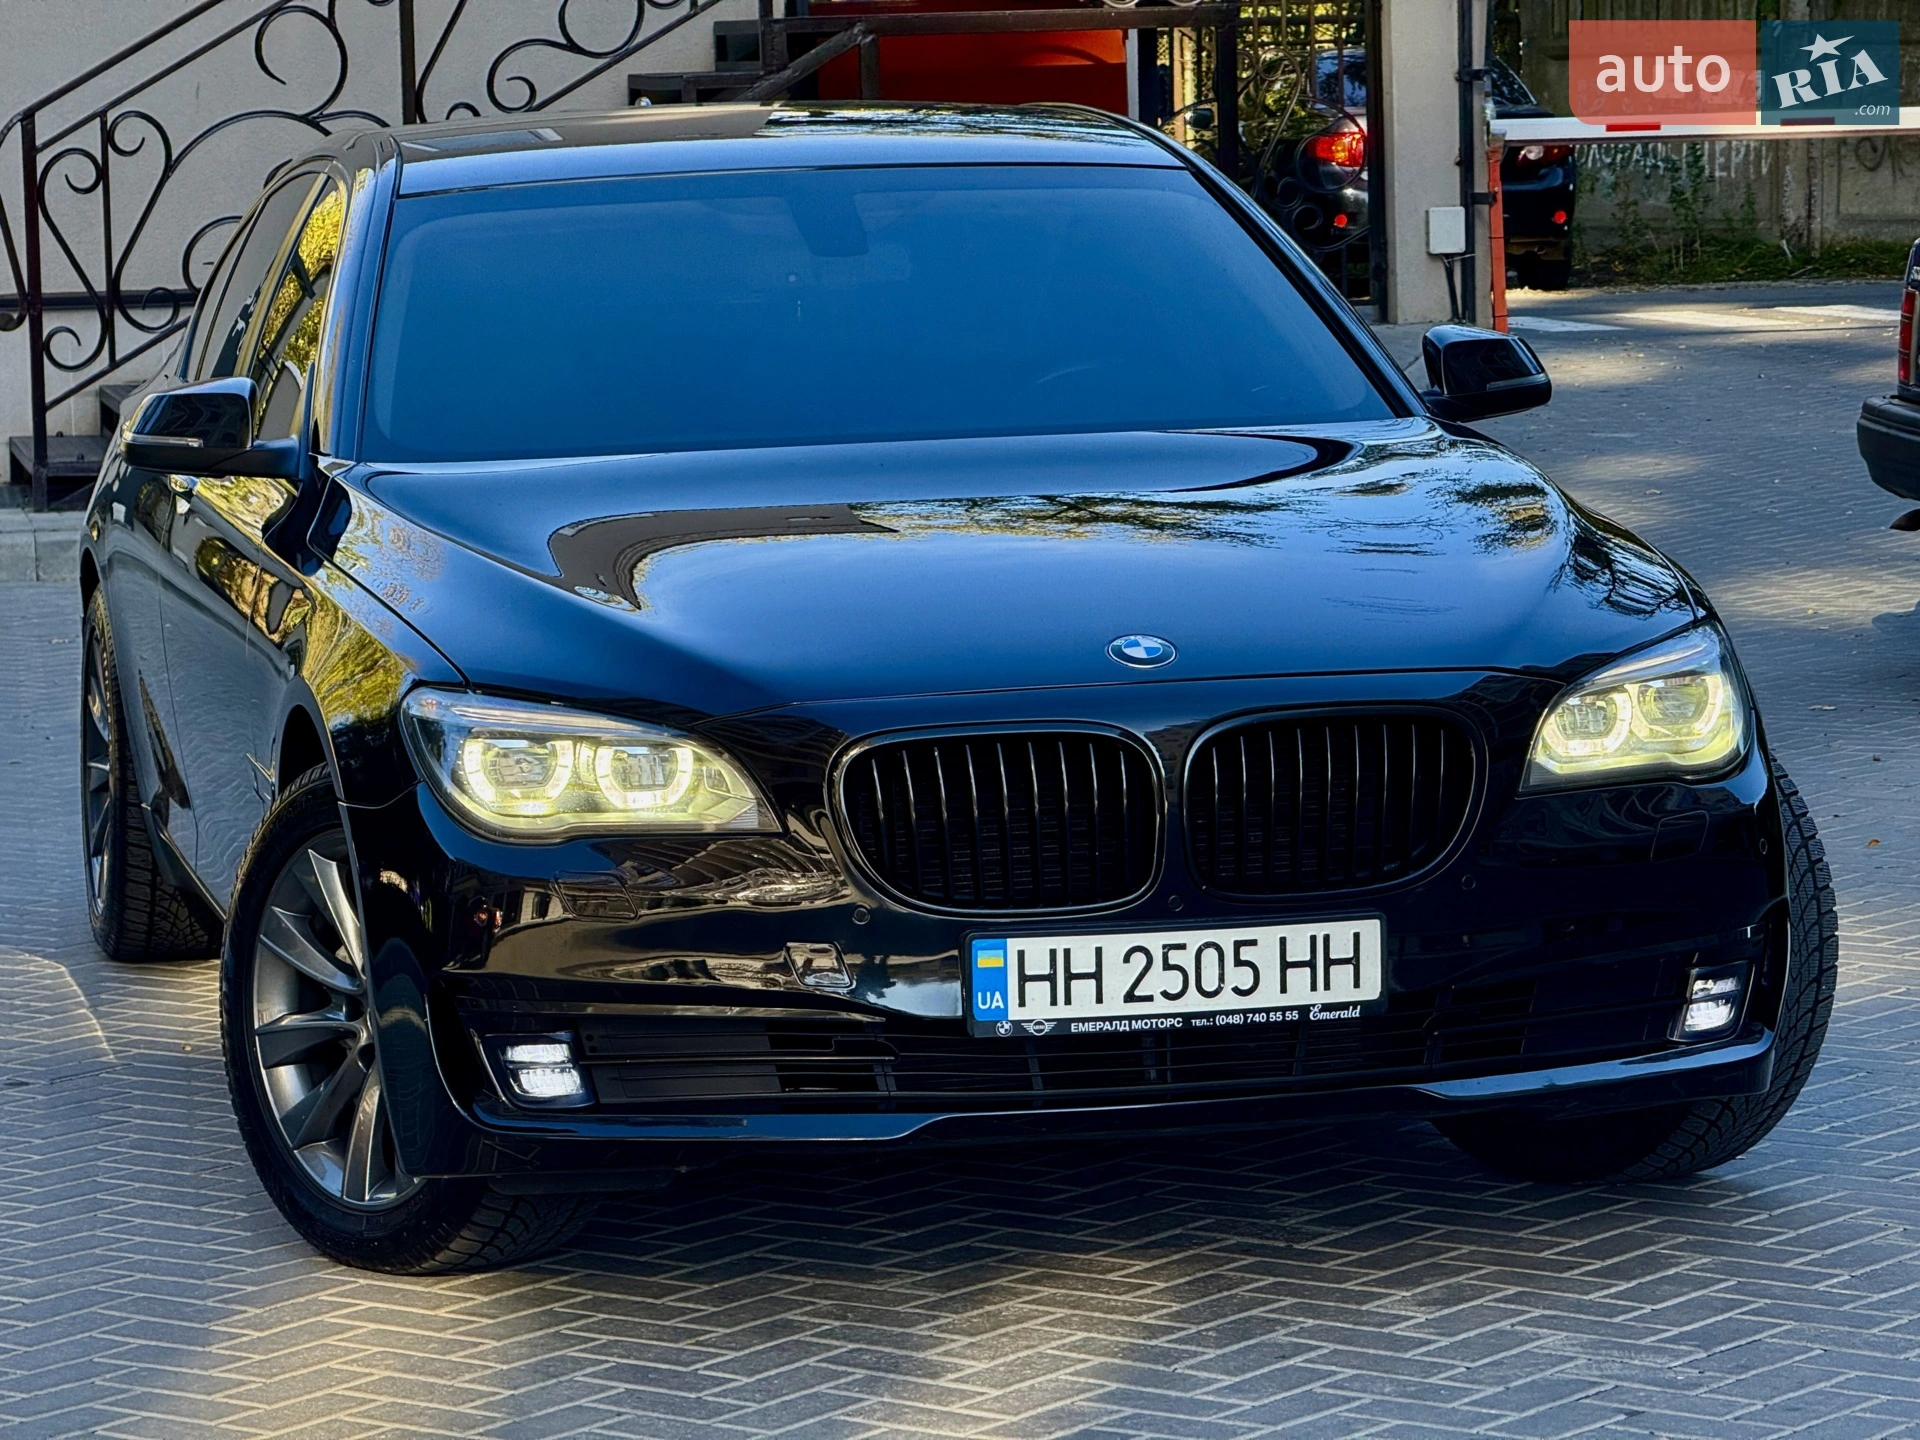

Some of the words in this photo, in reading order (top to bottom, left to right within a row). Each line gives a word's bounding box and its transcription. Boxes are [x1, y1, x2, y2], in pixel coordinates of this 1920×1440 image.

[1016, 946, 1103, 1008] HH
[1122, 938, 1261, 1004] 2505
[1279, 931, 1361, 995] HH
[977, 991, 1005, 1010] UA
[1070, 1020, 1130, 1033] ЕМЕРАЛД
[1131, 1017, 1183, 1030] МОТОРС
[1215, 1013, 1245, 1026] (048)
[1246, 1012, 1267, 1023] 740
[1269, 1011, 1283, 1022] 55
[1285, 1010, 1299, 1021] 55
[1309, 1003, 1361, 1021] Emerald
